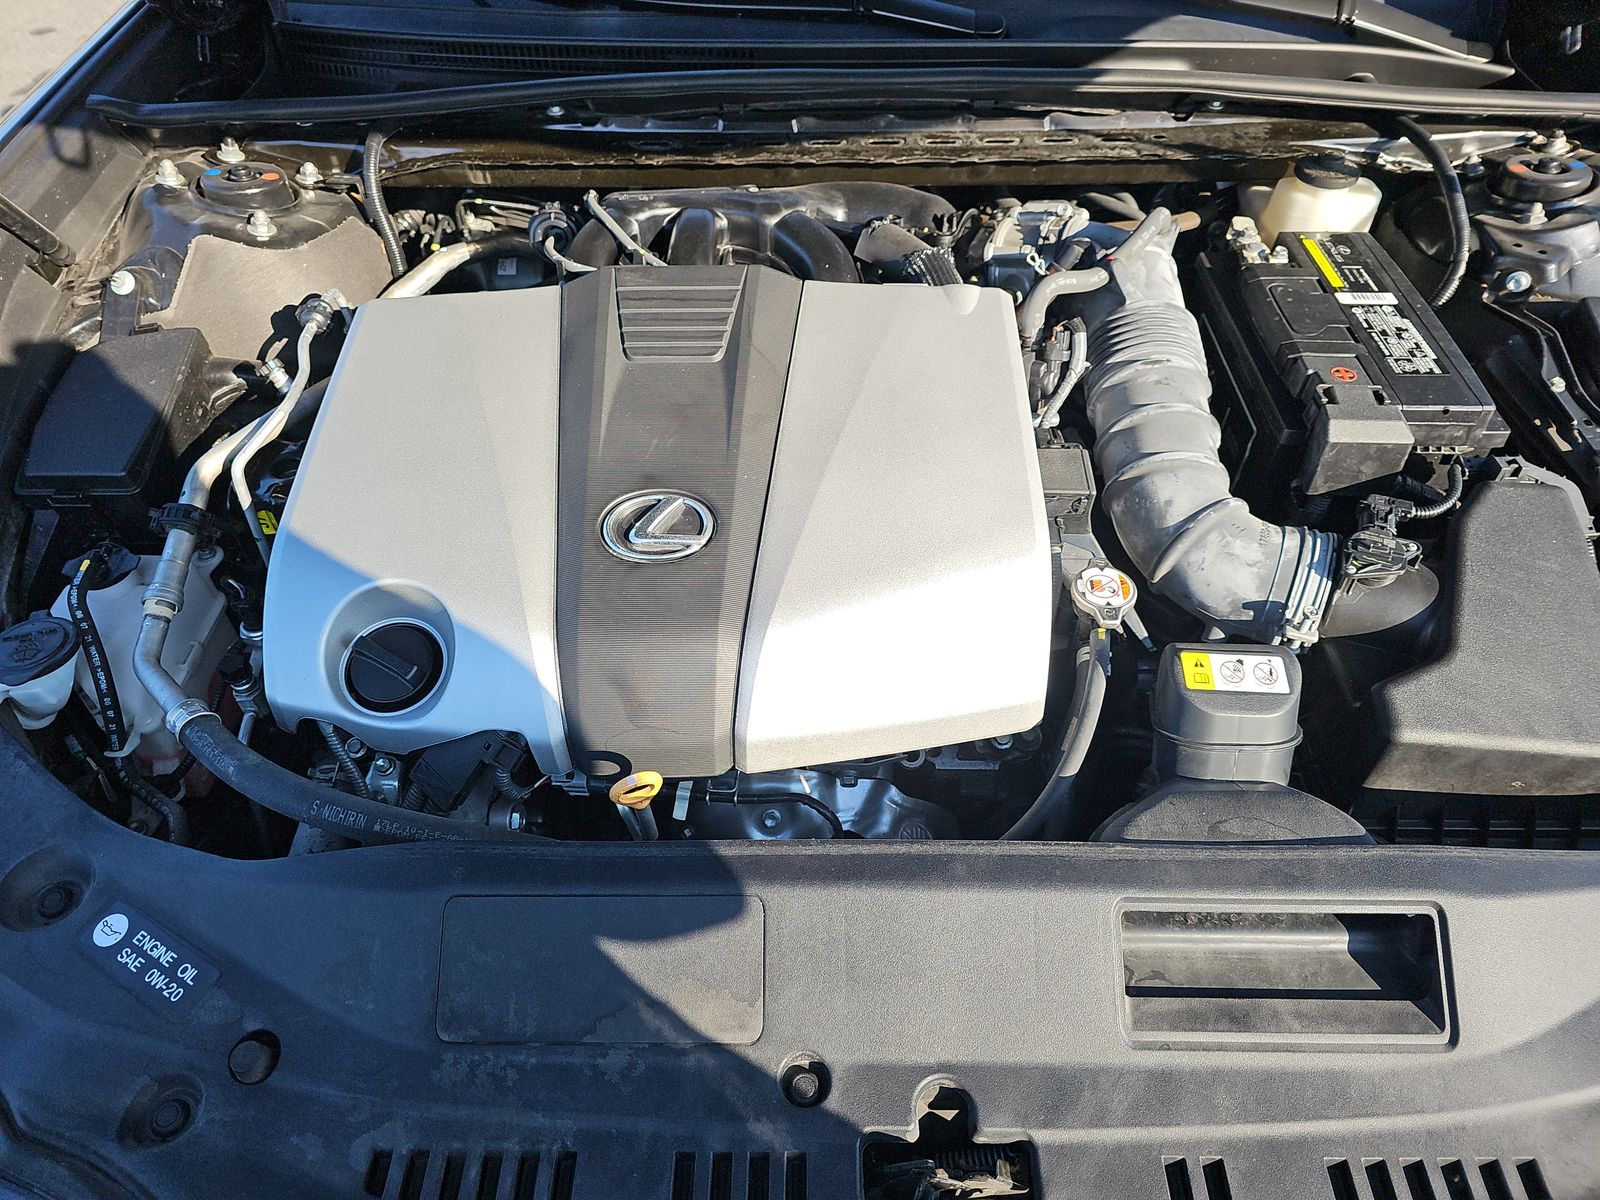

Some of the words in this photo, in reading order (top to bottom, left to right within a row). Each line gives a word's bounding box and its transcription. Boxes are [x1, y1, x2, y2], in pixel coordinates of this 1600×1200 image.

[89, 645, 100, 667] WATER
[117, 948, 146, 973] SAE
[144, 968, 184, 1002] 0W-20
[132, 930, 178, 967] ENGINE
[177, 963, 198, 986] OIL
